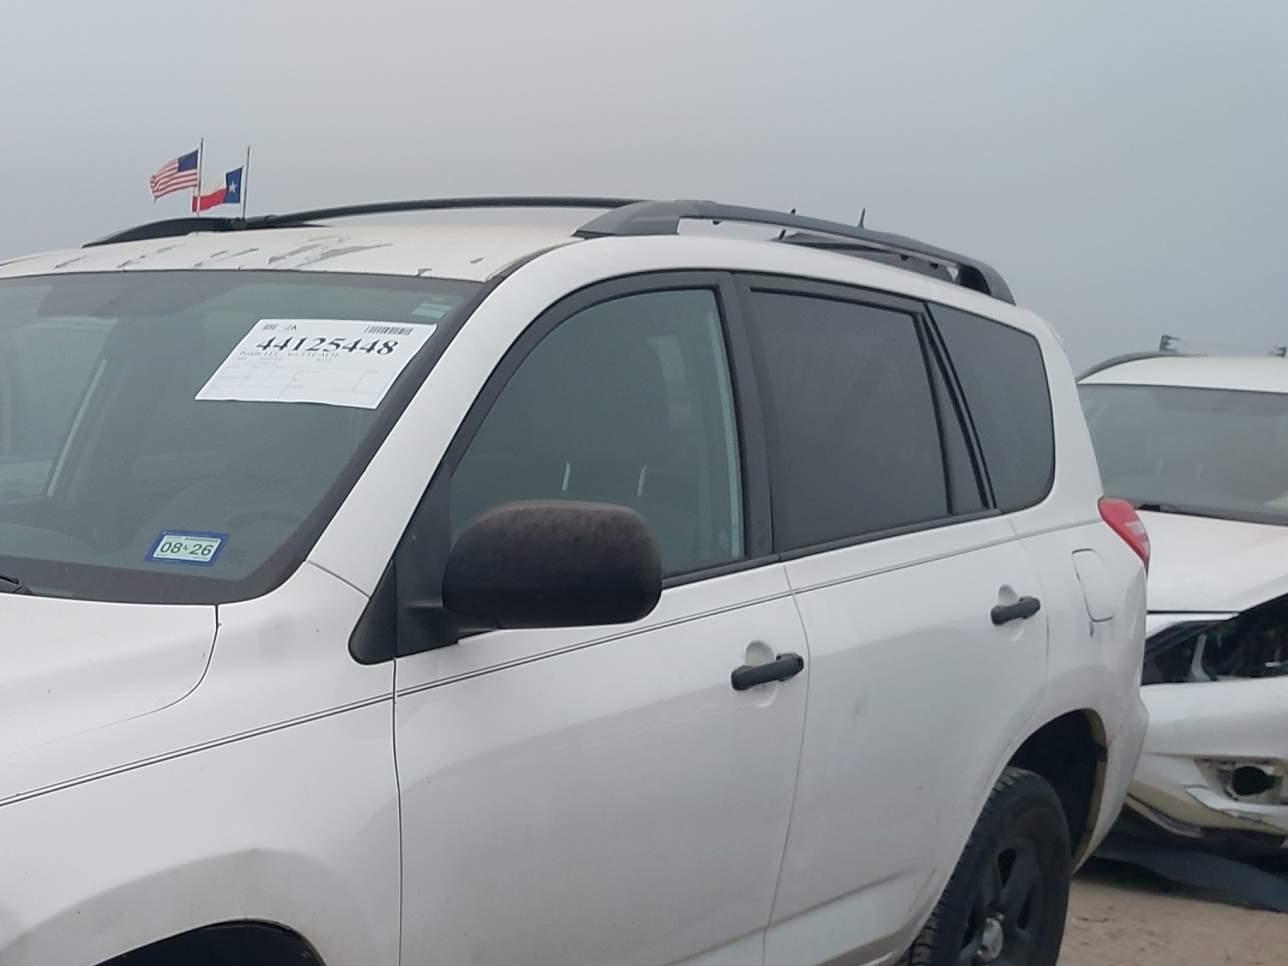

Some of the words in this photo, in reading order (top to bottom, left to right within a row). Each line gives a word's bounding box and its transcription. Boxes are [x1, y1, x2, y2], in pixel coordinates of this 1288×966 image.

[256, 336, 399, 356] 44125448
[160, 542, 183, 554] 08
[189, 543, 214, 556] 26
